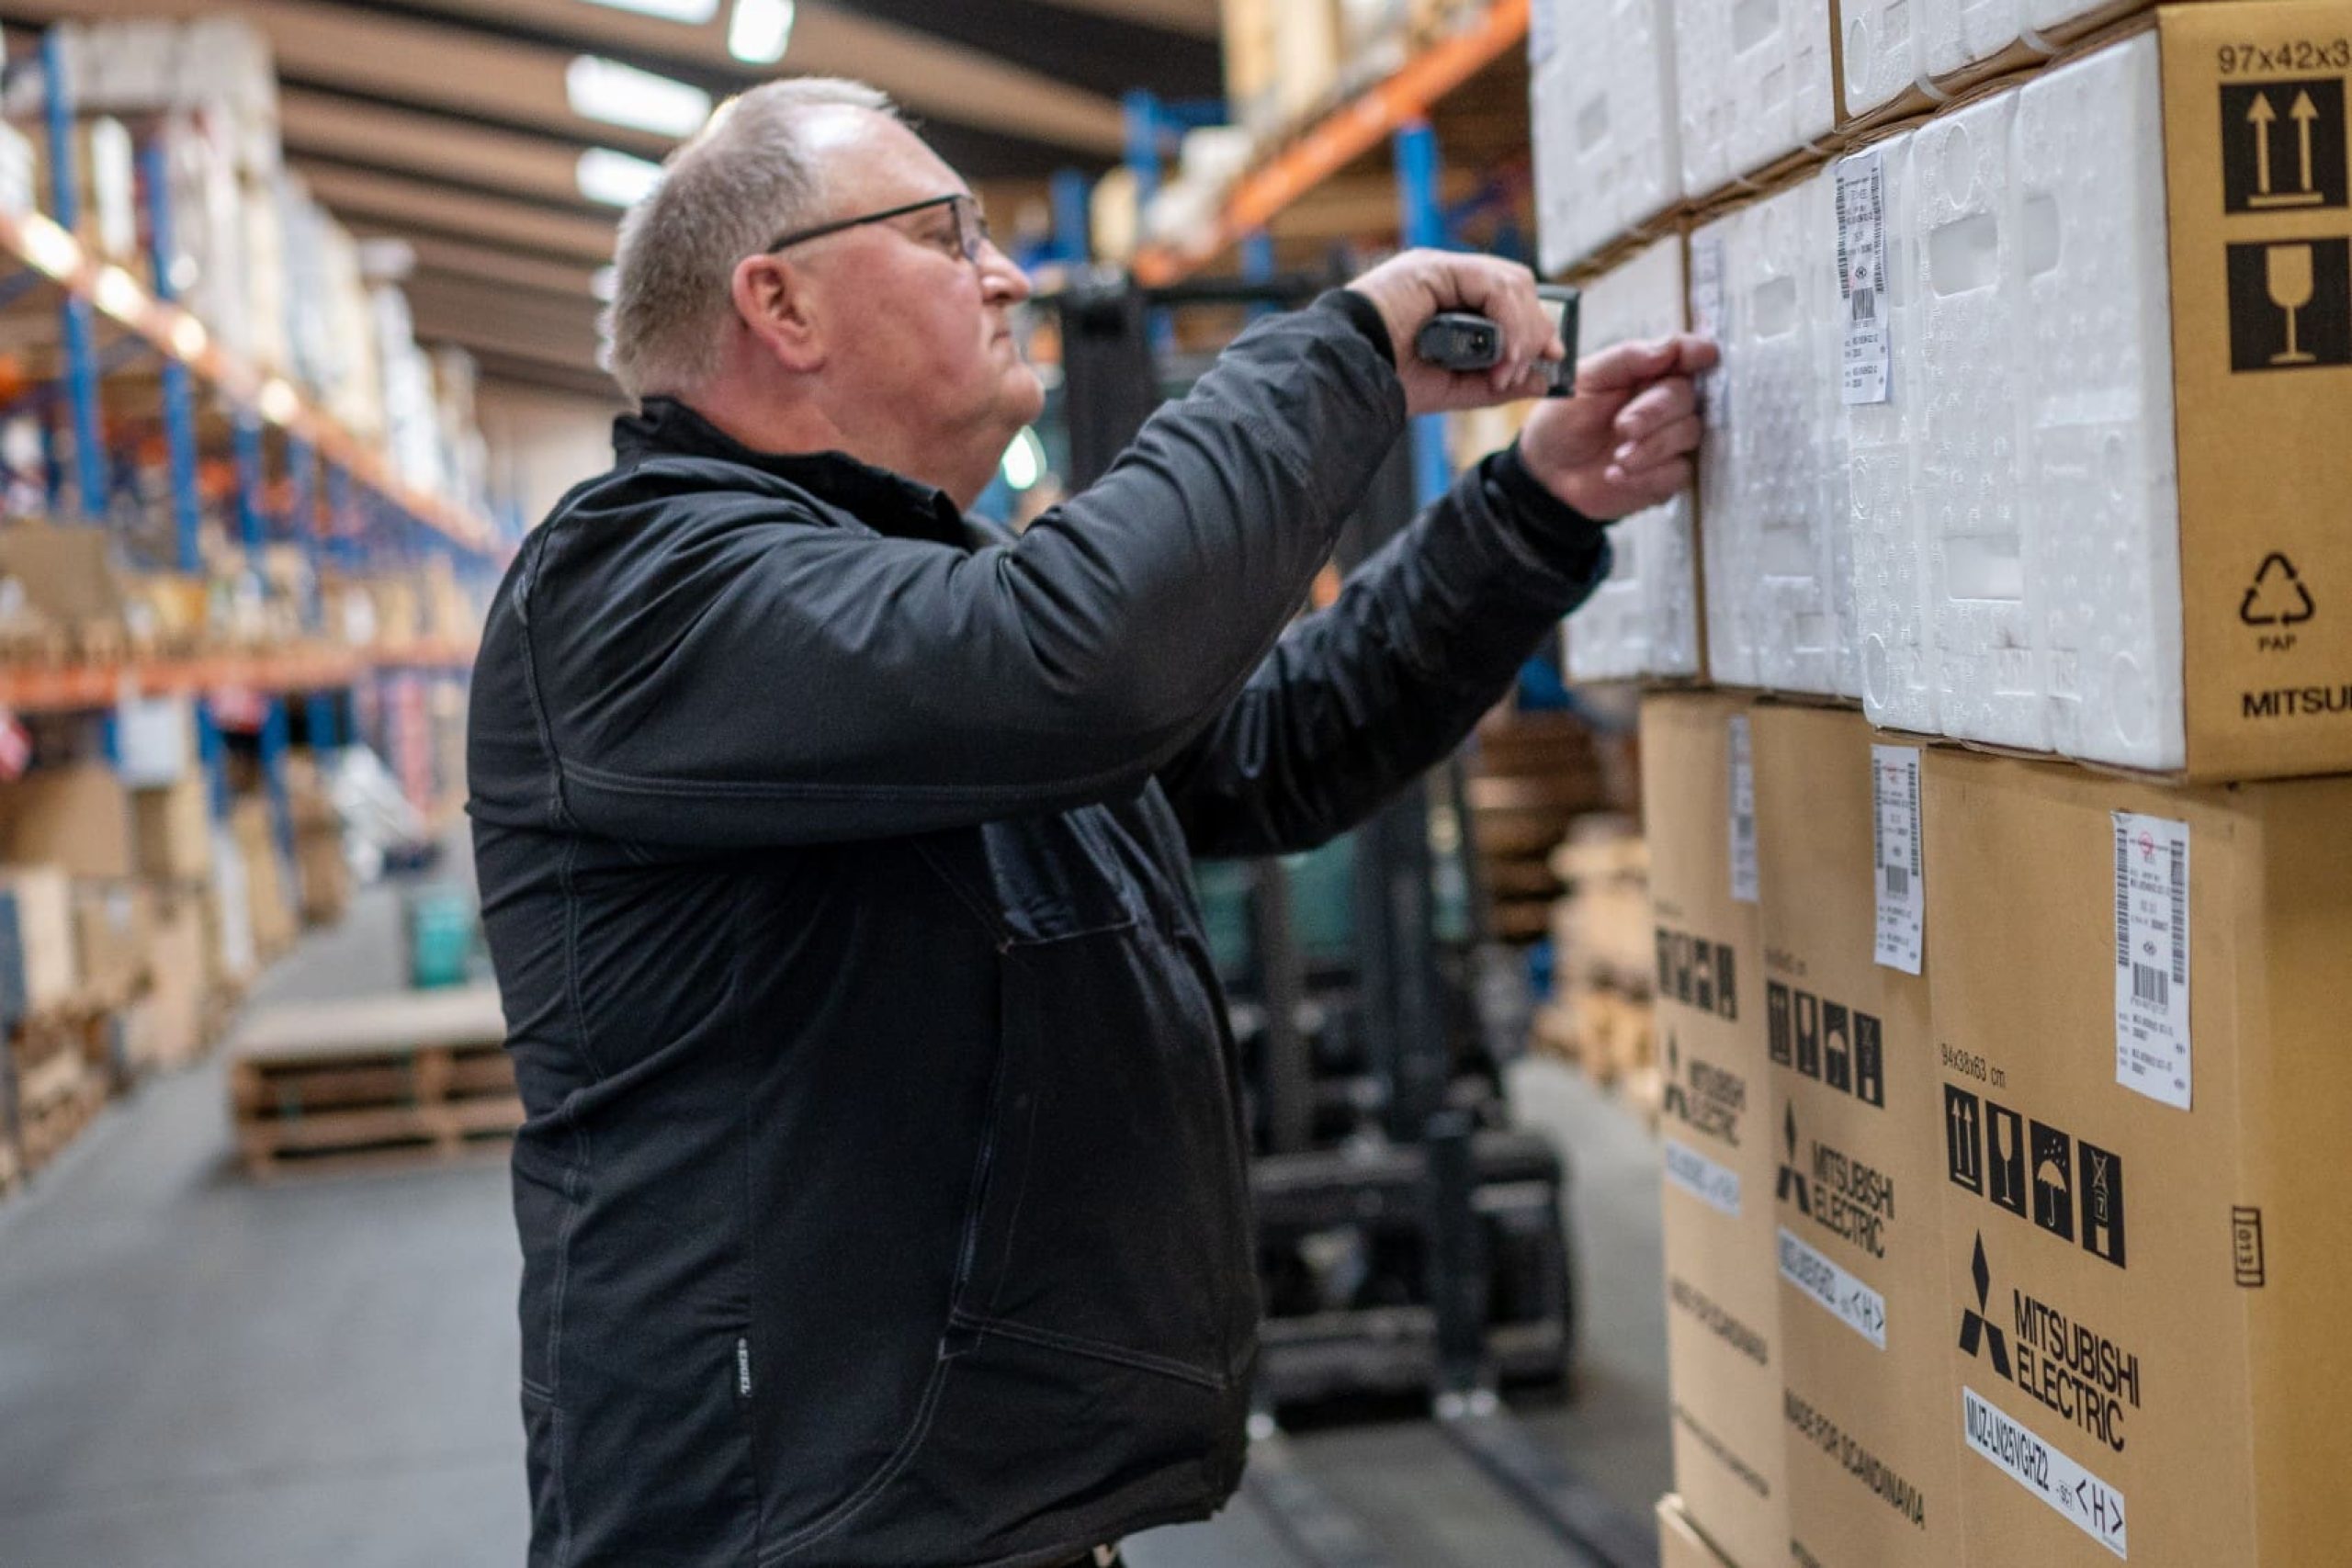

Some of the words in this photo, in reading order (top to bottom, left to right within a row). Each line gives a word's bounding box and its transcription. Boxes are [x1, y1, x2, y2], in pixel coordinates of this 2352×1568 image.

[2218, 39, 2350, 73] 97x42x3
[2258, 634, 2296, 651] PAP
[2242, 684, 2352, 717] MITSU
[1991, 1066, 2007, 1088] cm
[1812, 1139, 1894, 1220] MITSUBISHI
[1814, 1181, 1884, 1258] ELECTRIC
[2013, 1288, 2140, 1409] MITSUBISHI
[2017, 1341, 2125, 1452] ELECTRIC
